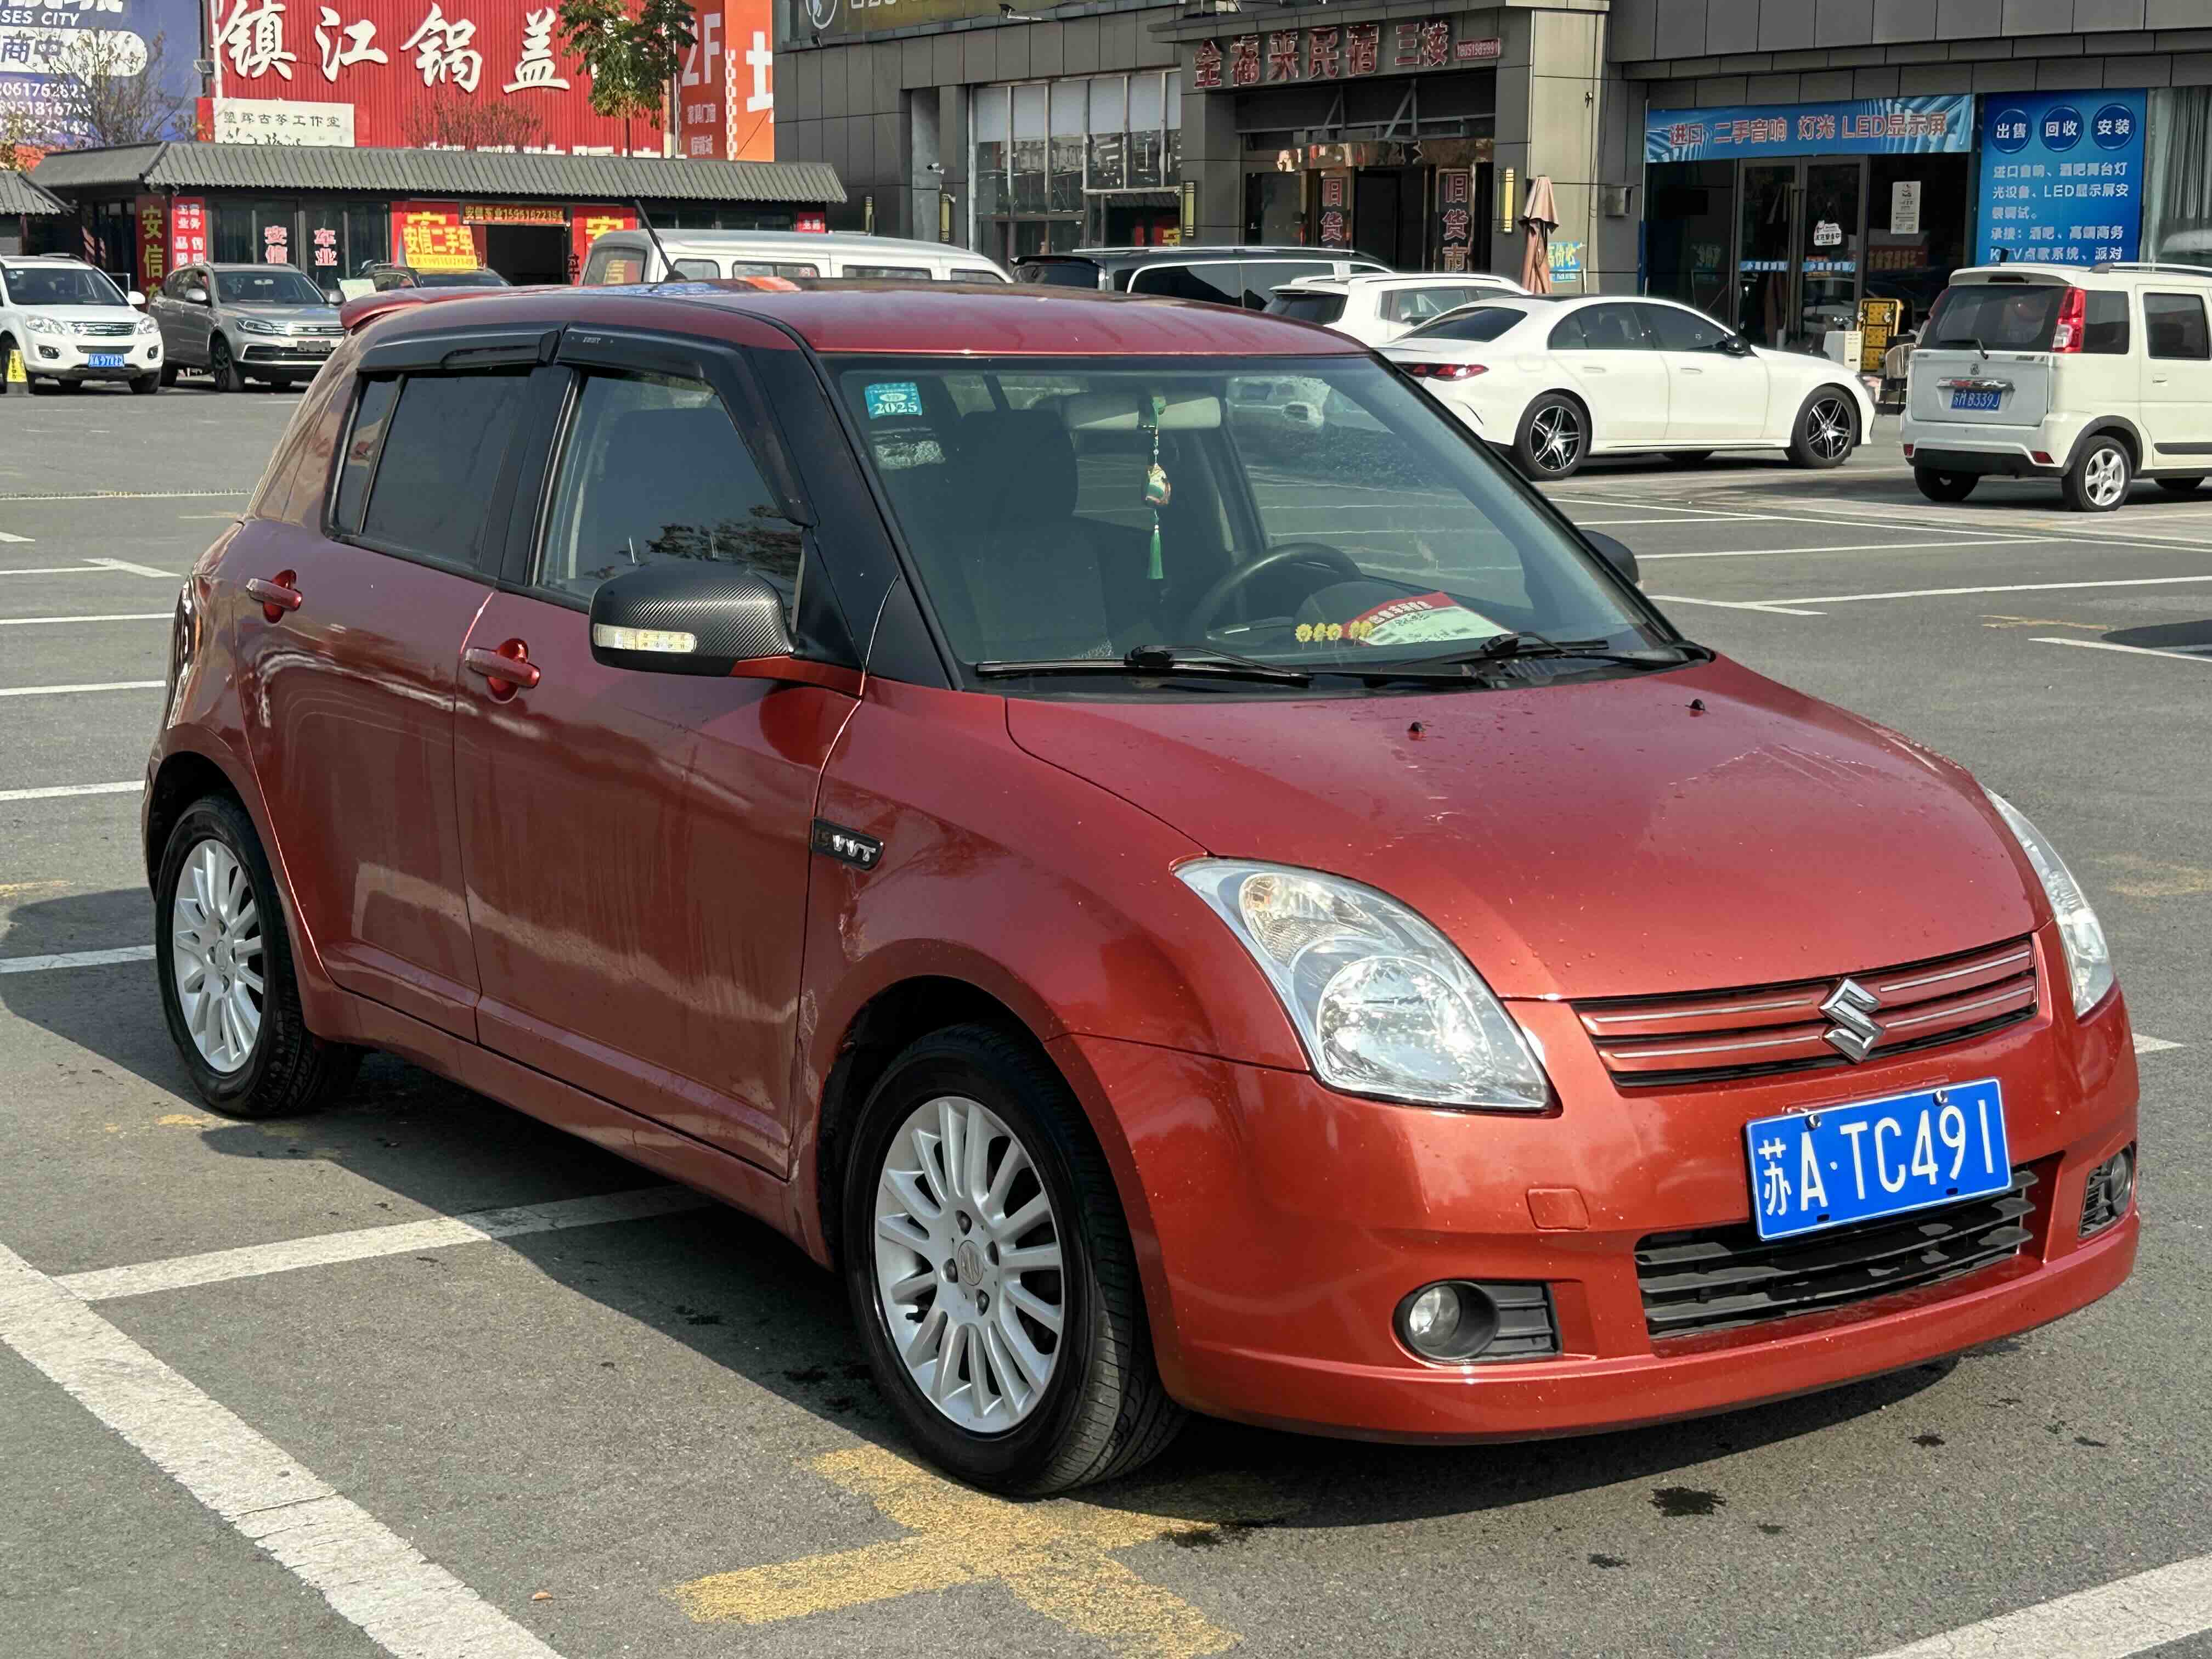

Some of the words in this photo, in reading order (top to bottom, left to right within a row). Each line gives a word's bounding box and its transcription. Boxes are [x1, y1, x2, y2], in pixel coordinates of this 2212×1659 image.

[0, 9, 33, 24] SES
[41, 12, 80, 26] CITY
[218, 0, 571, 94] 镇江锅盖
[1668, 123, 1703, 148] 进口
[1713, 117, 1787, 144] 二手音响
[1797, 115, 1835, 141] 灯光
[1842, 112, 1947, 139] LED显示屏
[1996, 123, 2026, 139] 出售
[2045, 120, 2078, 137] 回收
[2097, 119, 2130, 136] 安装
[402, 225, 475, 256] 安信二手车
[873, 402, 918, 415] 2025
[1758, 1099, 1994, 1216] 苏A·TC491
